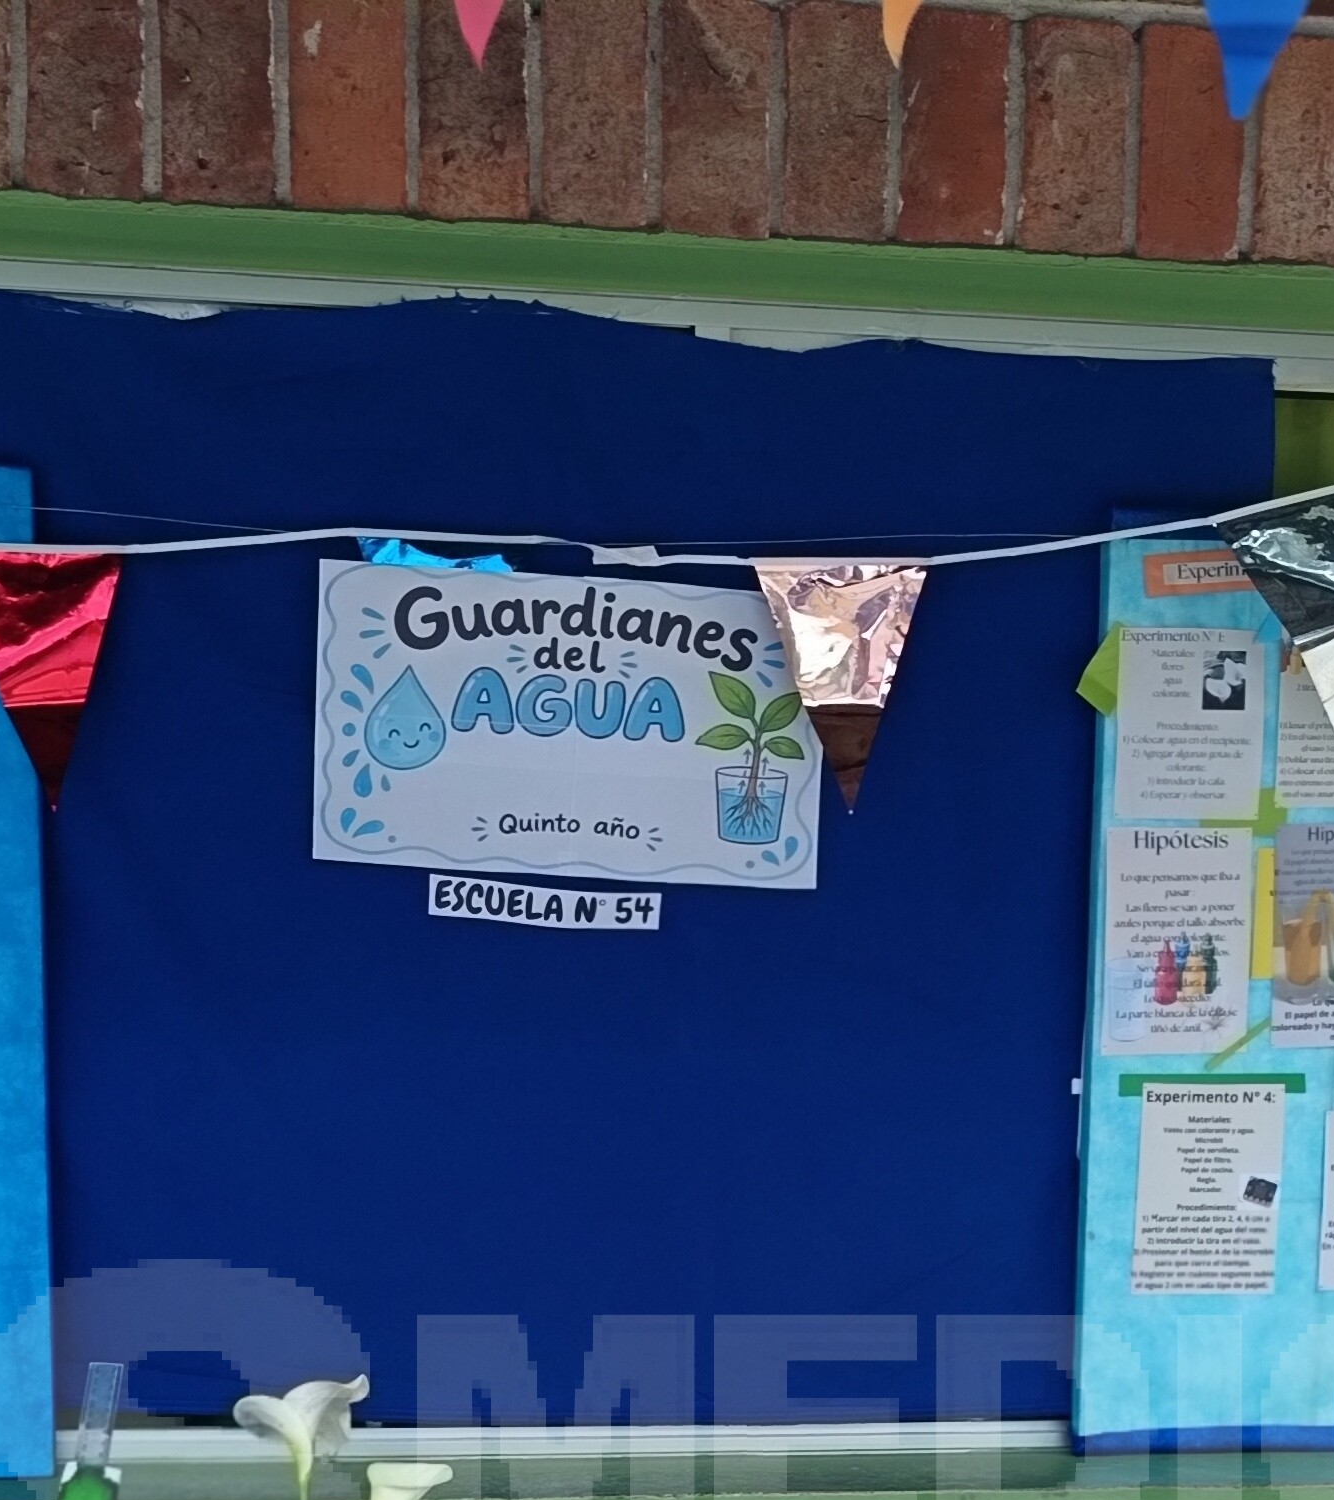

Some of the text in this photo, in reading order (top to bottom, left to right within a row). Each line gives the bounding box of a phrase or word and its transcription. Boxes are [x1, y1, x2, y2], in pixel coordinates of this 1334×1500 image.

[394, 586, 758, 672] Guardianes
[1121, 630, 1200, 644] Experimento
[533, 638, 605, 673] del
[451, 667, 685, 742] AGUA
[499, 812, 640, 839] Quinto año
[1134, 830, 1229, 855] Hipótesis
[435, 879, 654, 924] ESCUELA N° 54
[1147, 1091, 1238, 1105] Experimento
[1264, 1092, 1276, 1103] 4:
